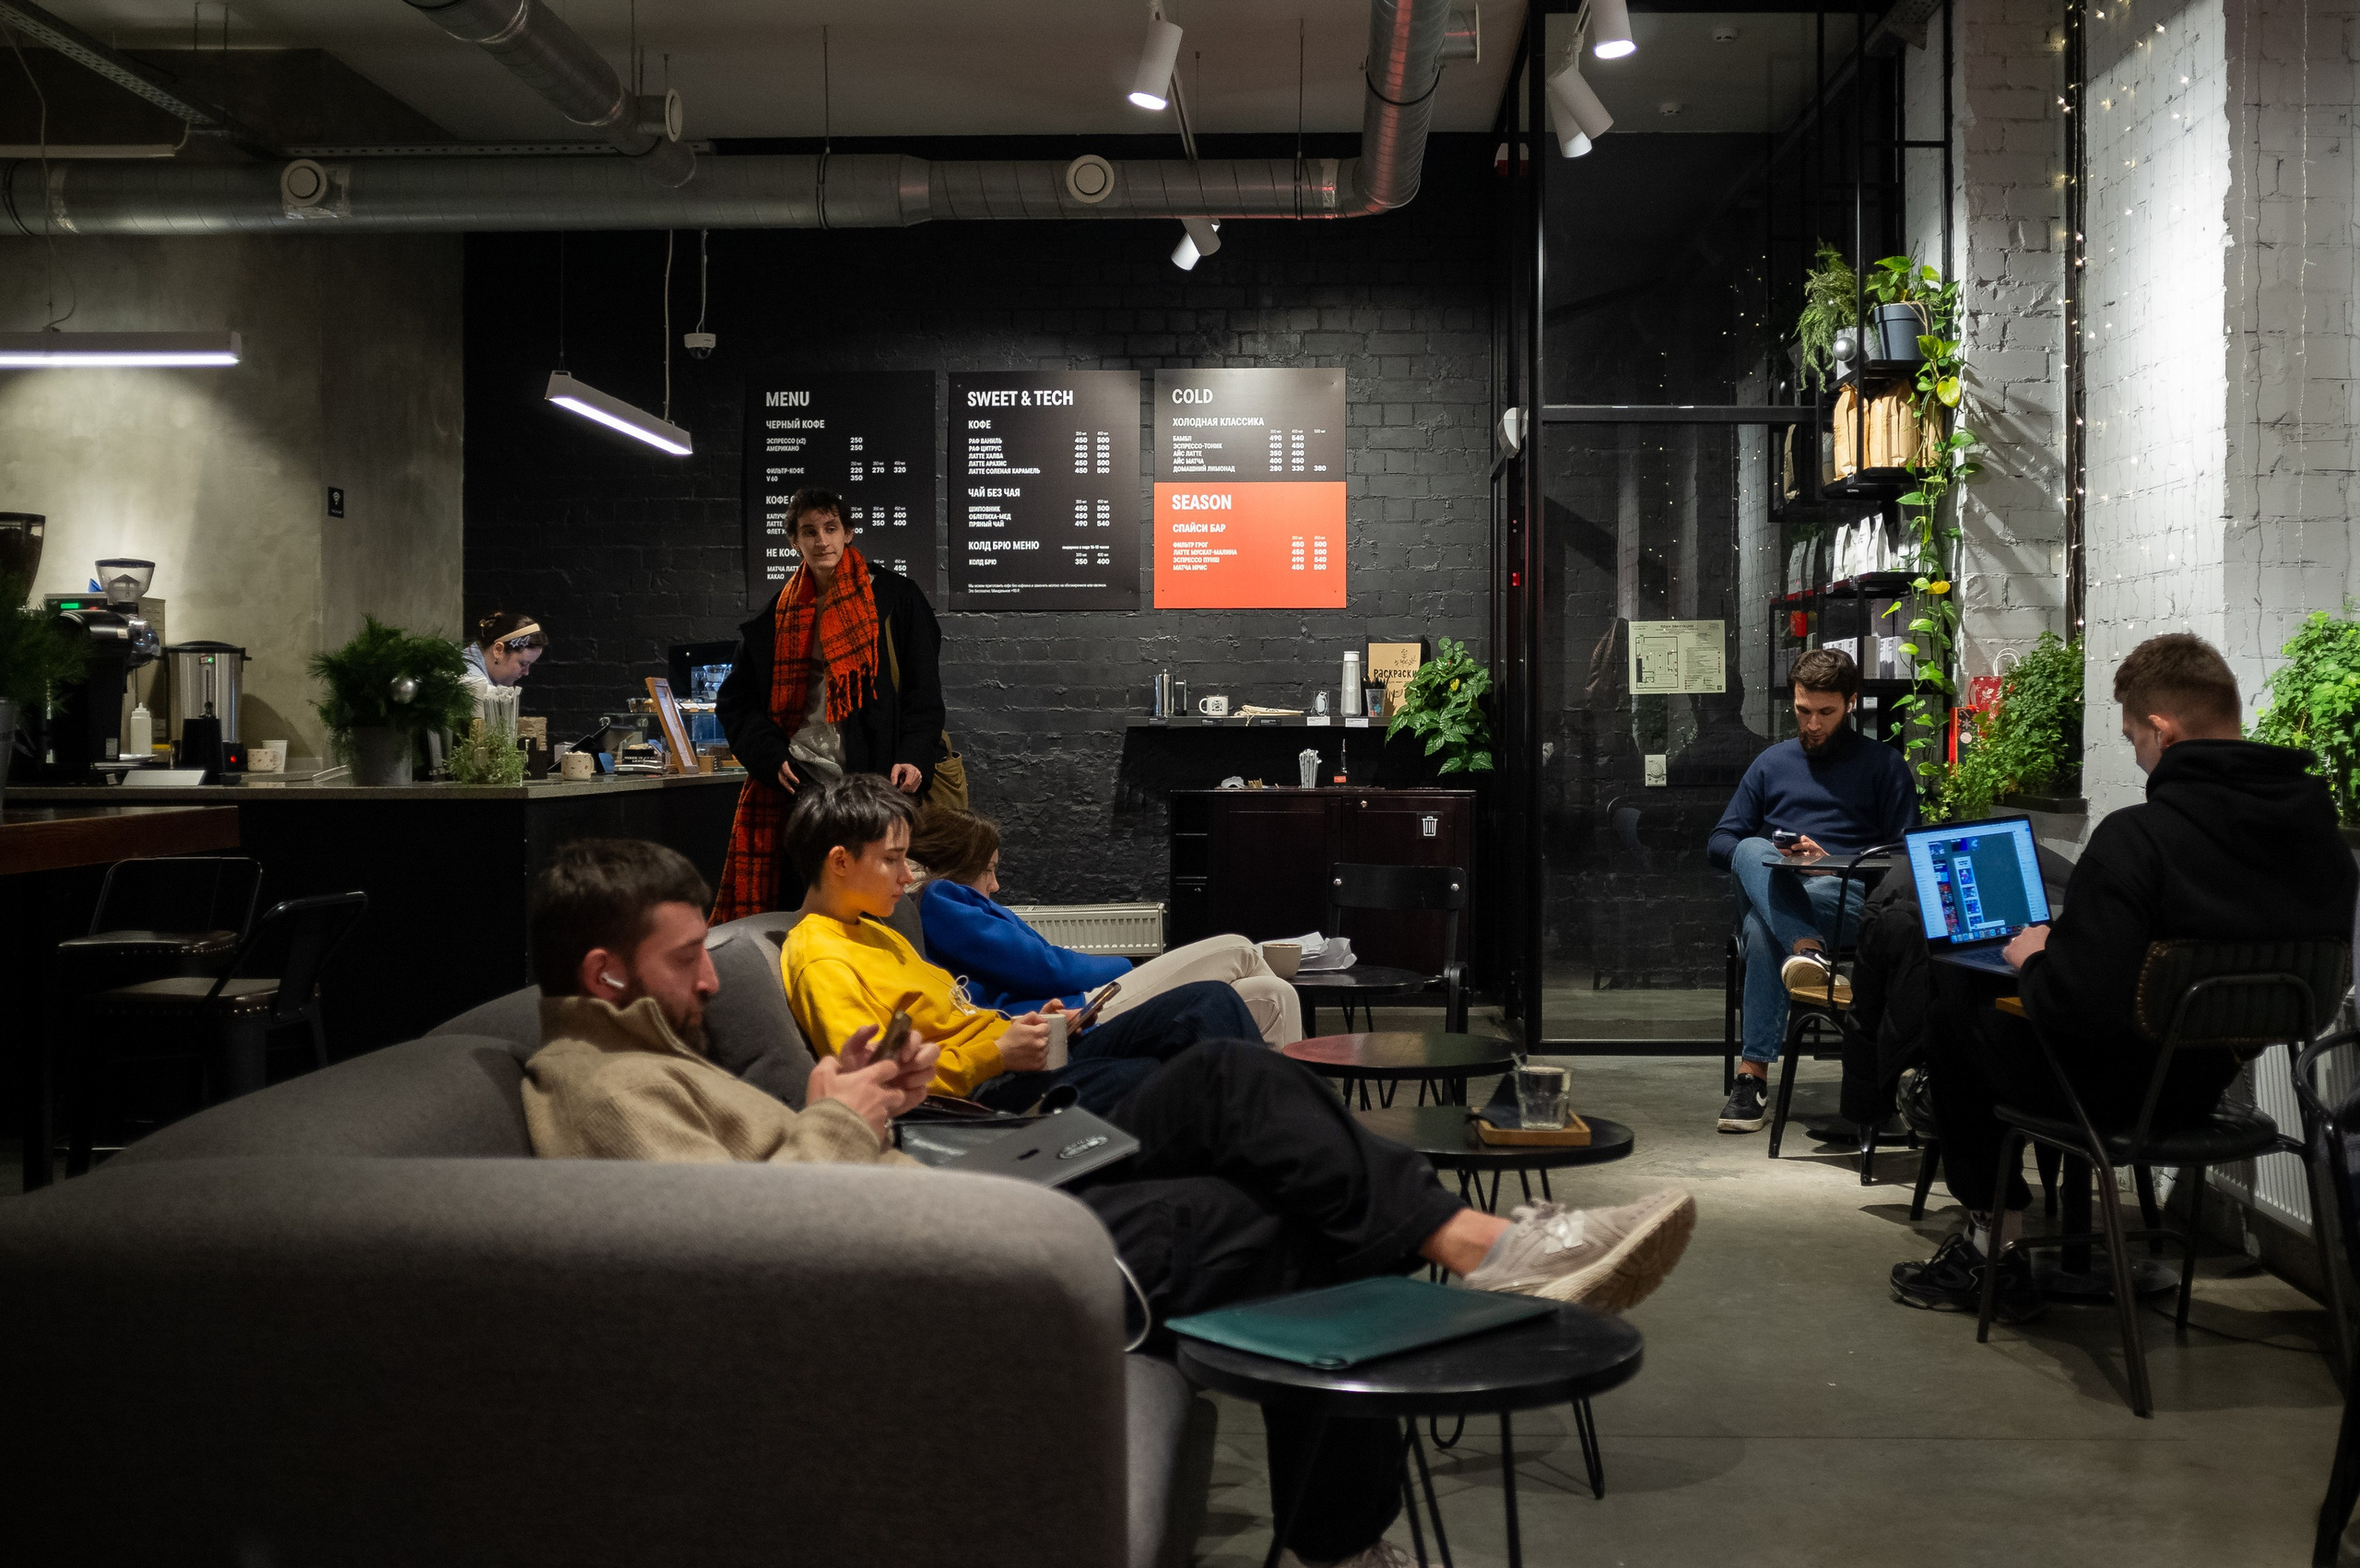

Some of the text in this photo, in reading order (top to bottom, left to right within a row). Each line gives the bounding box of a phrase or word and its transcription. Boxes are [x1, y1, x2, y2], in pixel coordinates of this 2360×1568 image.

[766, 392, 809, 407] MENU
[968, 390, 1073, 407] SWEET & TECH
[1173, 388, 1213, 404] COLD
[766, 419, 824, 429] ЧЕРНЫЙ КОФЕ
[969, 420, 991, 429] КОФЕ
[1173, 418, 1264, 426] ХОЛОДНАЯ КЛАССИКА
[968, 487, 1020, 497] ЧАЙ БЕЗ ЧАЯ
[766, 496, 788, 504] КОФЕ
[1172, 494, 1232, 510] SEASON
[1173, 522, 1226, 533] СПАЙСИ БАР
[969, 541, 1039, 551] КОЛД БРЮ МЕНЮ
[766, 548, 799, 557] НЕ КОФ
